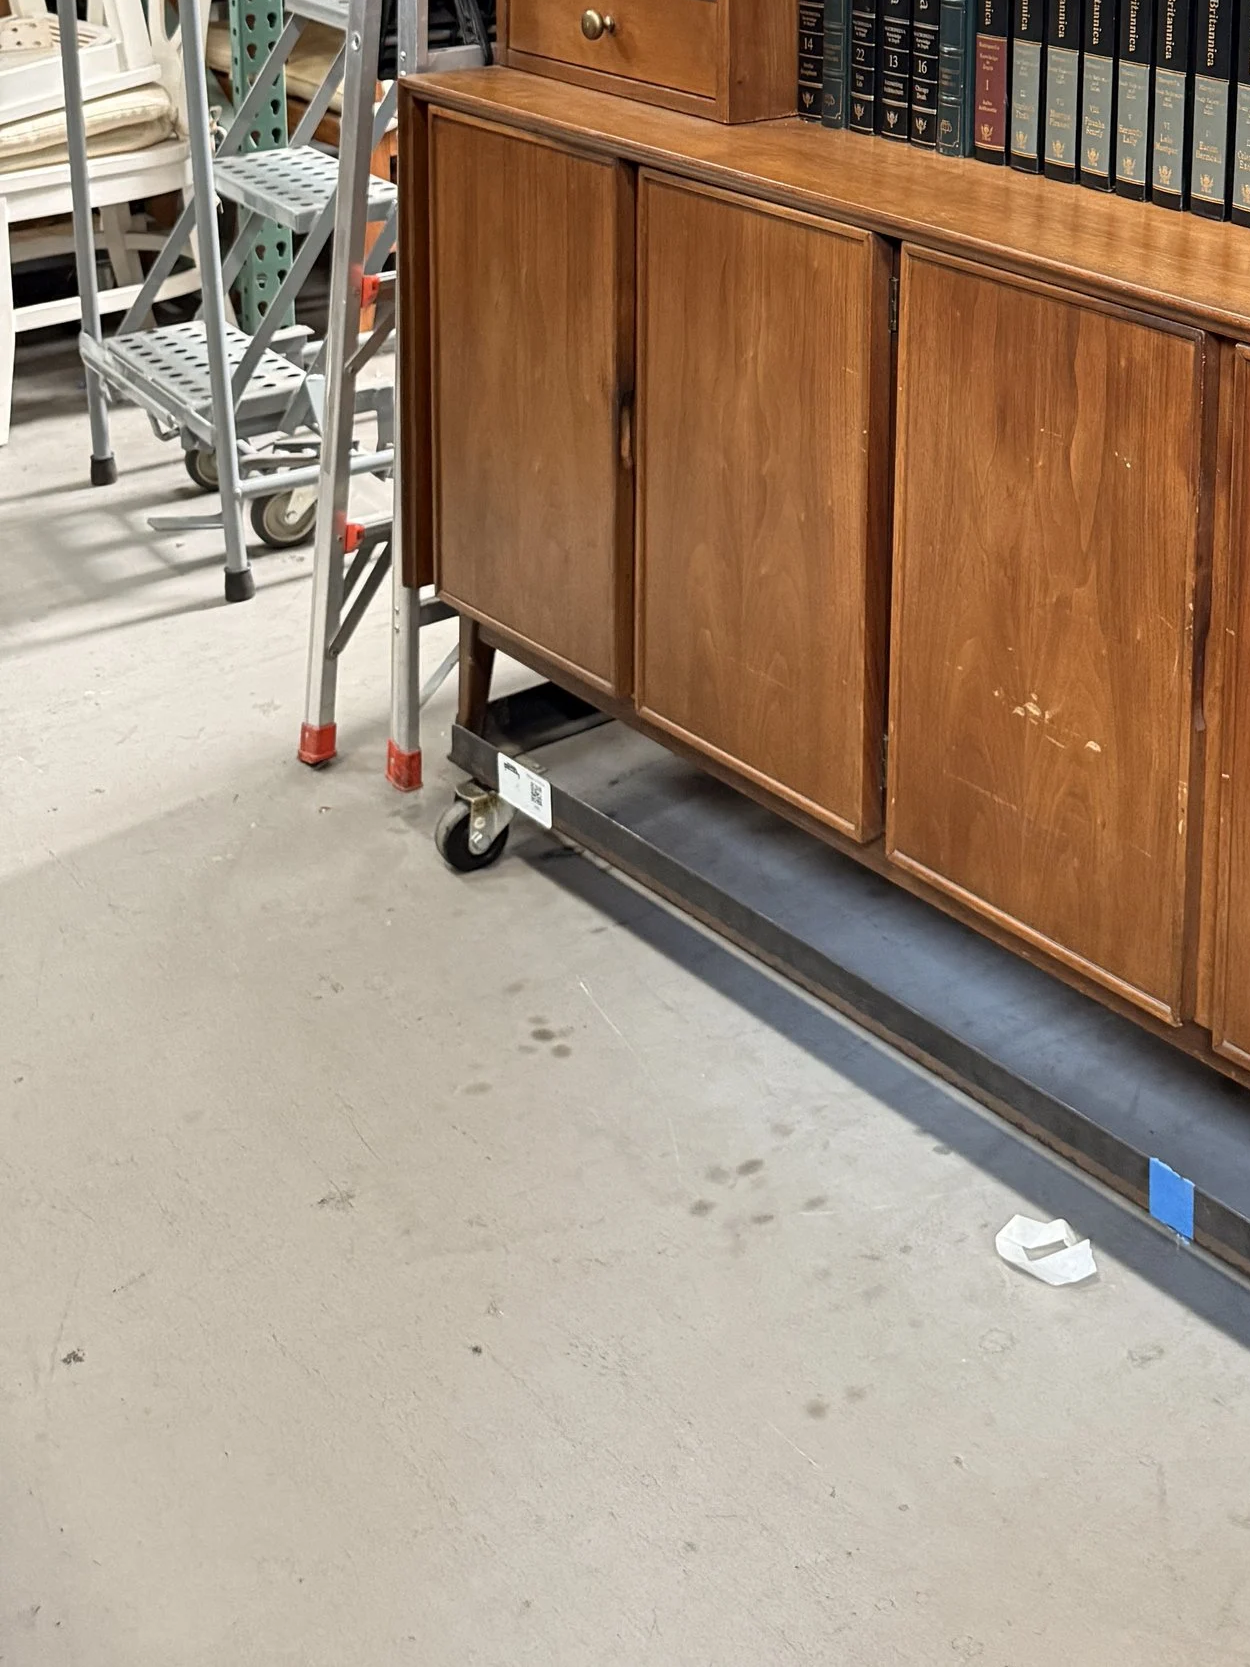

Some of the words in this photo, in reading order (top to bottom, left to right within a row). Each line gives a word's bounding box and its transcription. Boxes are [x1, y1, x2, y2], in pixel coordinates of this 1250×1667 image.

[804, 37, 813, 51] 14
[856, 49, 865, 61] 22
[889, 55, 898, 68] 13
[918, 60, 928, 74] 16
[985, 79, 989, 91] 1
